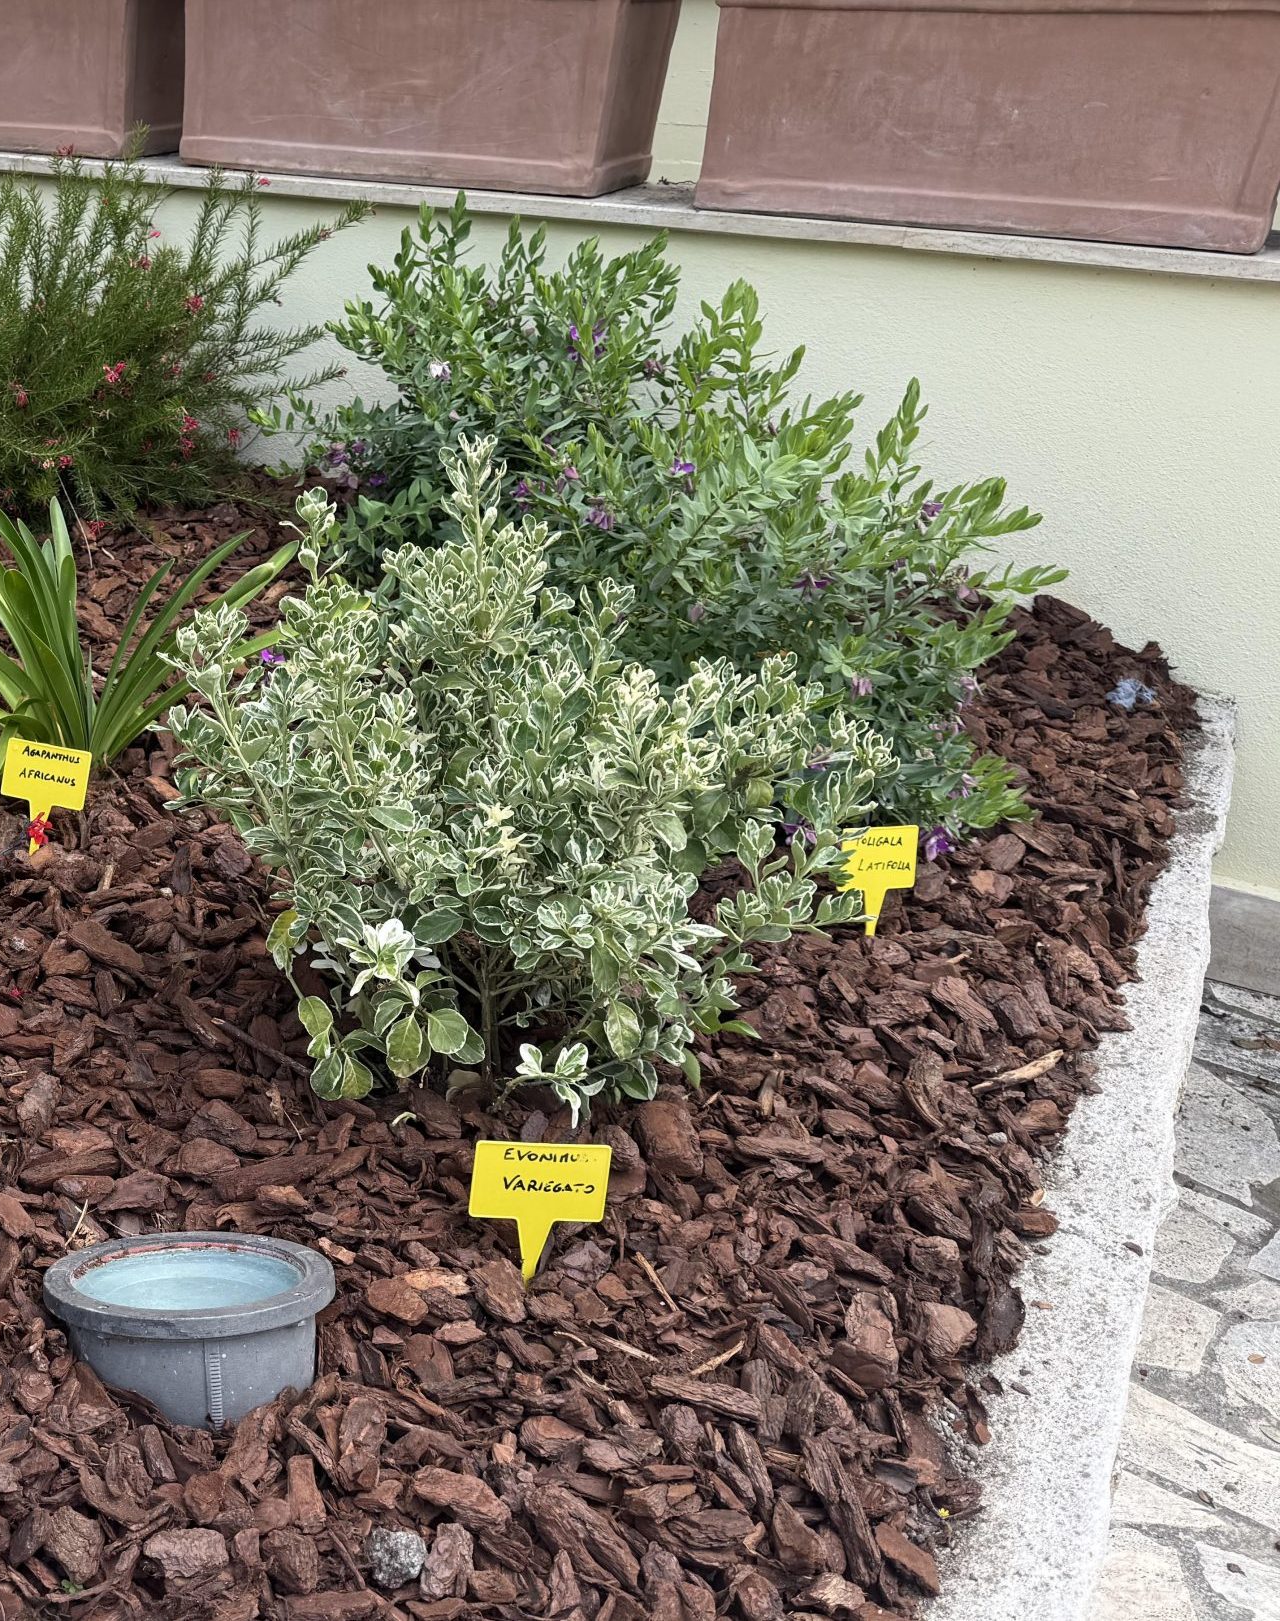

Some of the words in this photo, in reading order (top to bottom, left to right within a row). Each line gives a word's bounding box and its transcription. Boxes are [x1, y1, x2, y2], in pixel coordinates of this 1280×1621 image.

[22, 745, 80, 764] AGAPANTHUS
[19, 767, 76, 787] AFRICANUS
[857, 858, 911, 872] LATIFOLIA
